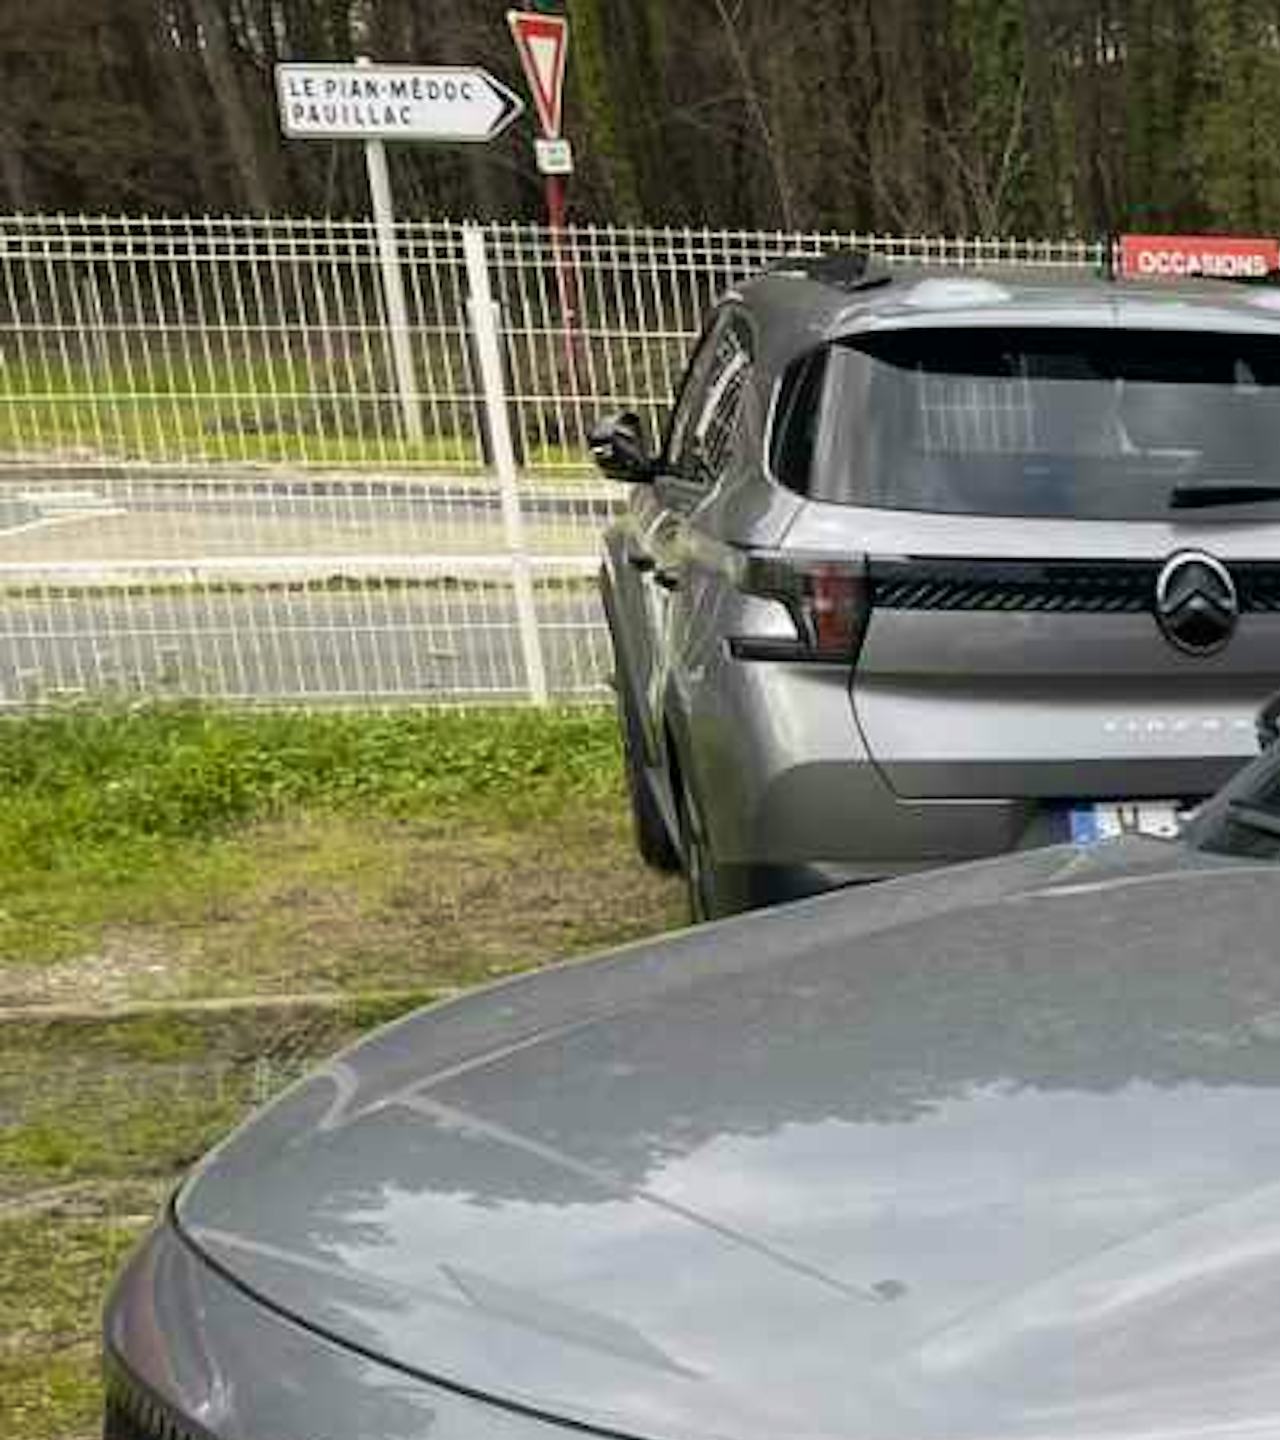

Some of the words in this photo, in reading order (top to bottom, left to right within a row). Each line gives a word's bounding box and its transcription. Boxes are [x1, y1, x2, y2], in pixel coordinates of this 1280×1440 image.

[288, 79, 315, 97] LE
[324, 76, 474, 101] PIAN-MÉDOC
[291, 103, 412, 127] PAUILLAC
[1138, 251, 1268, 276] OCCASIONS
